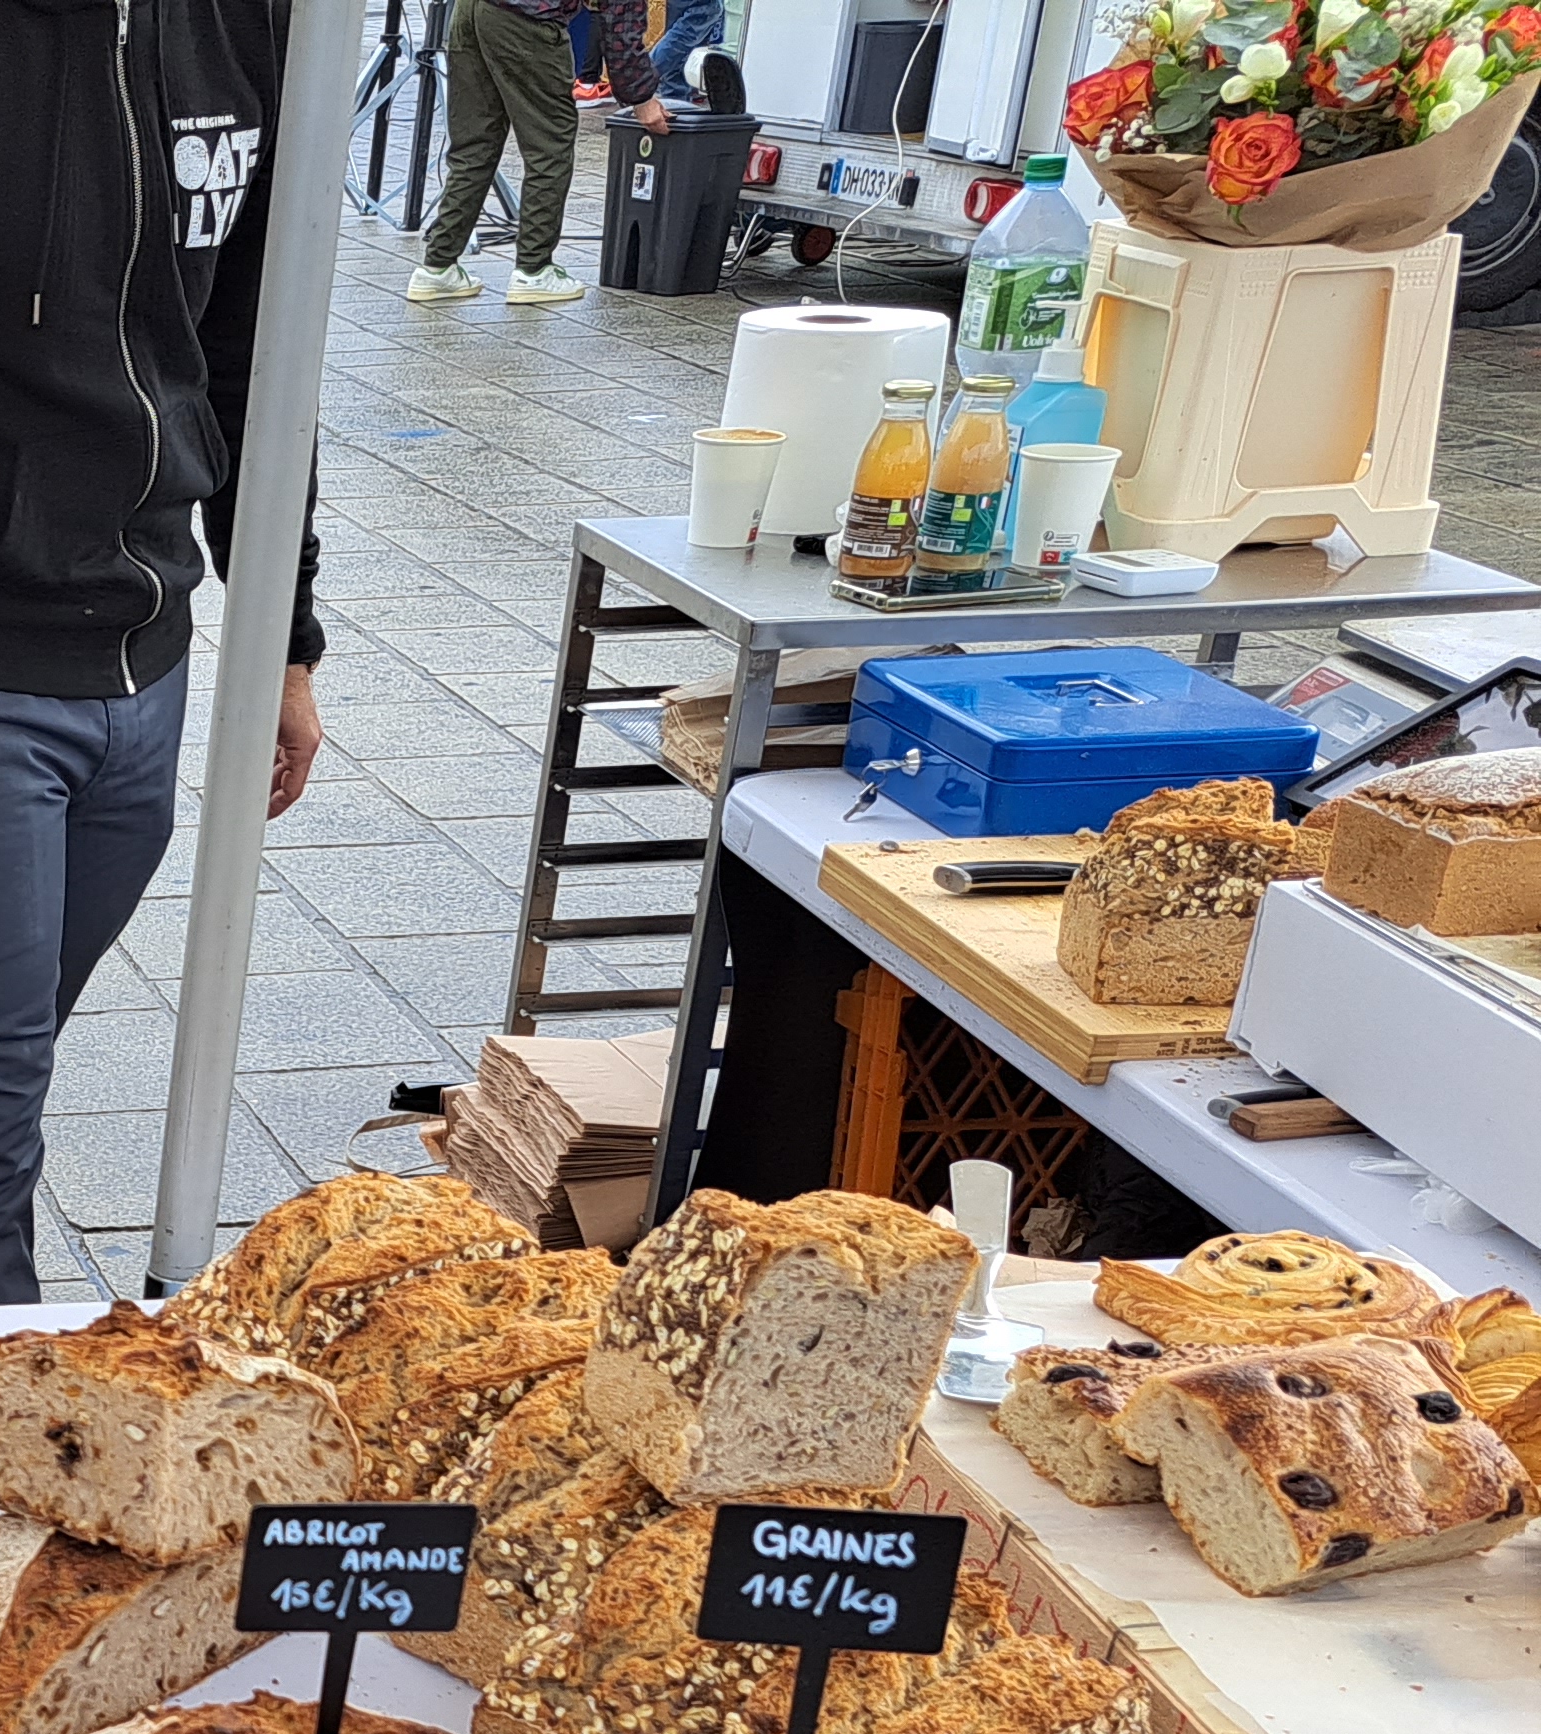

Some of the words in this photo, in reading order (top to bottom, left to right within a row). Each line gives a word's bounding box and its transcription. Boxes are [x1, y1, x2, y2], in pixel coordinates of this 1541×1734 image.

[263, 1518, 386, 1547] ABRICOT
[753, 1520, 917, 1568] GRAINES
[340, 1546, 466, 1575] AMANDE
[740, 1571, 898, 1635] 11€/kg
